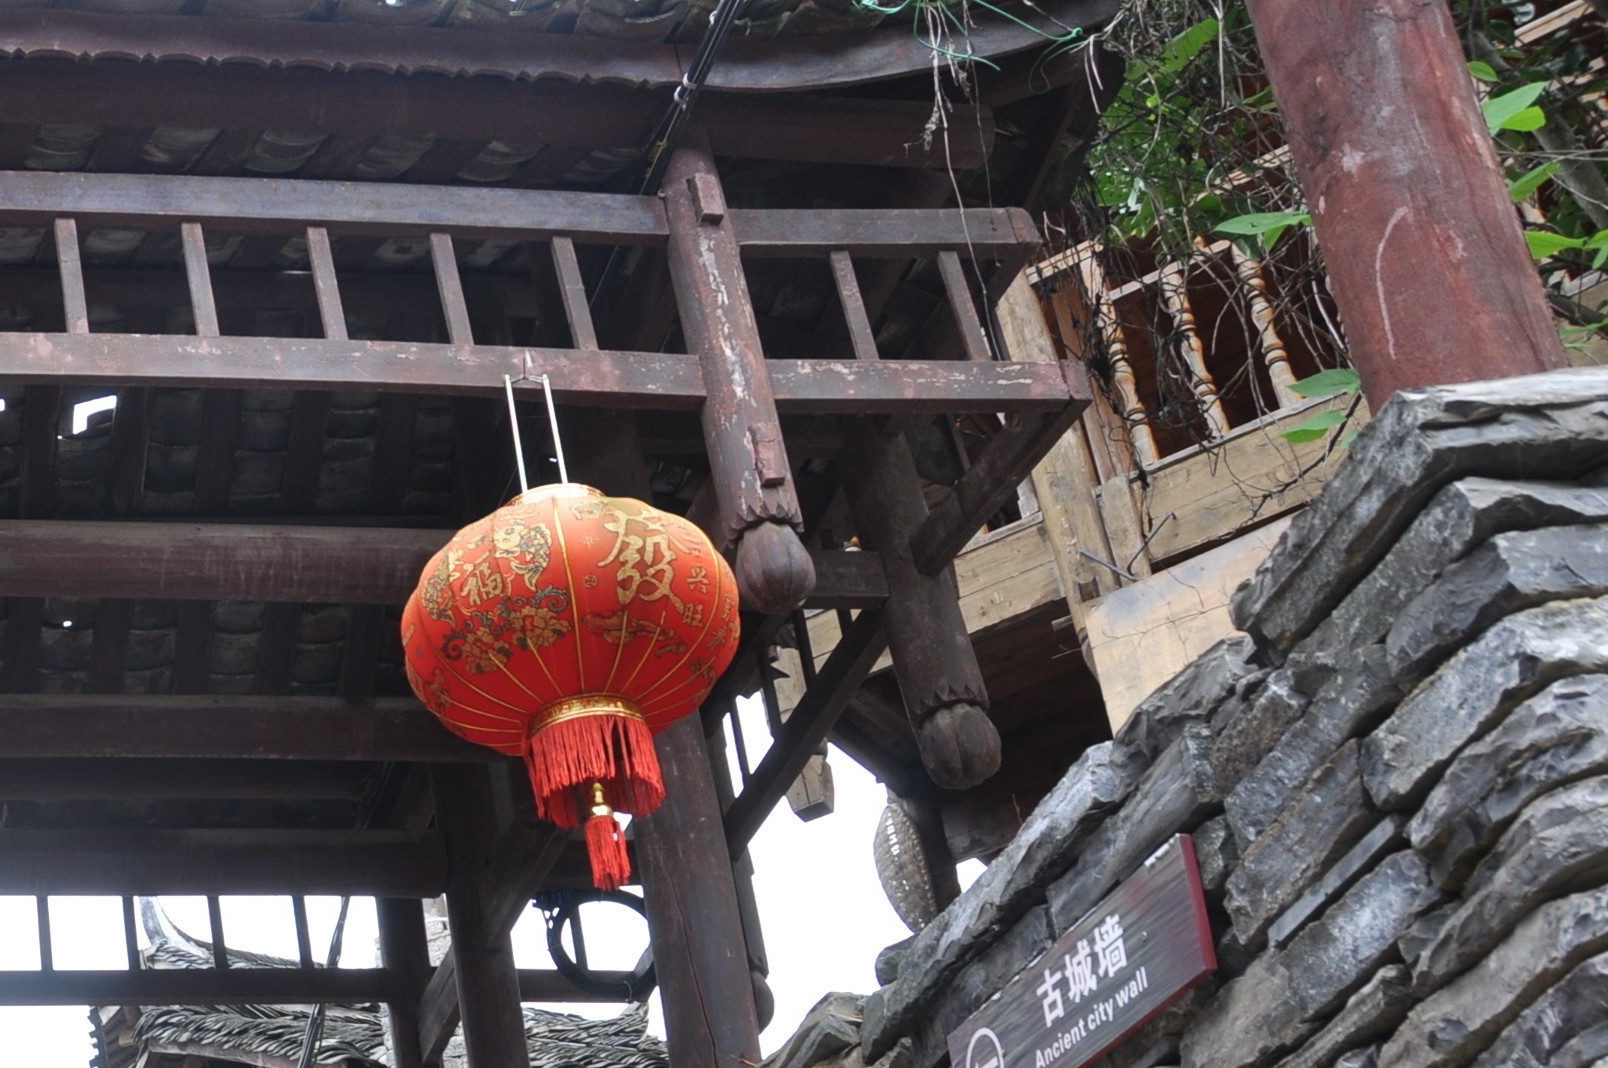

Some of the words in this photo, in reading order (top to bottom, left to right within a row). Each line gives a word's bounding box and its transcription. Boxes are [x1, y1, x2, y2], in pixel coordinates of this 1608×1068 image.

[461, 552, 503, 605] 福
[1036, 913, 1128, 1028] 古城墙
[1087, 998, 1114, 1031] city
[1116, 966, 1149, 1008] wall
